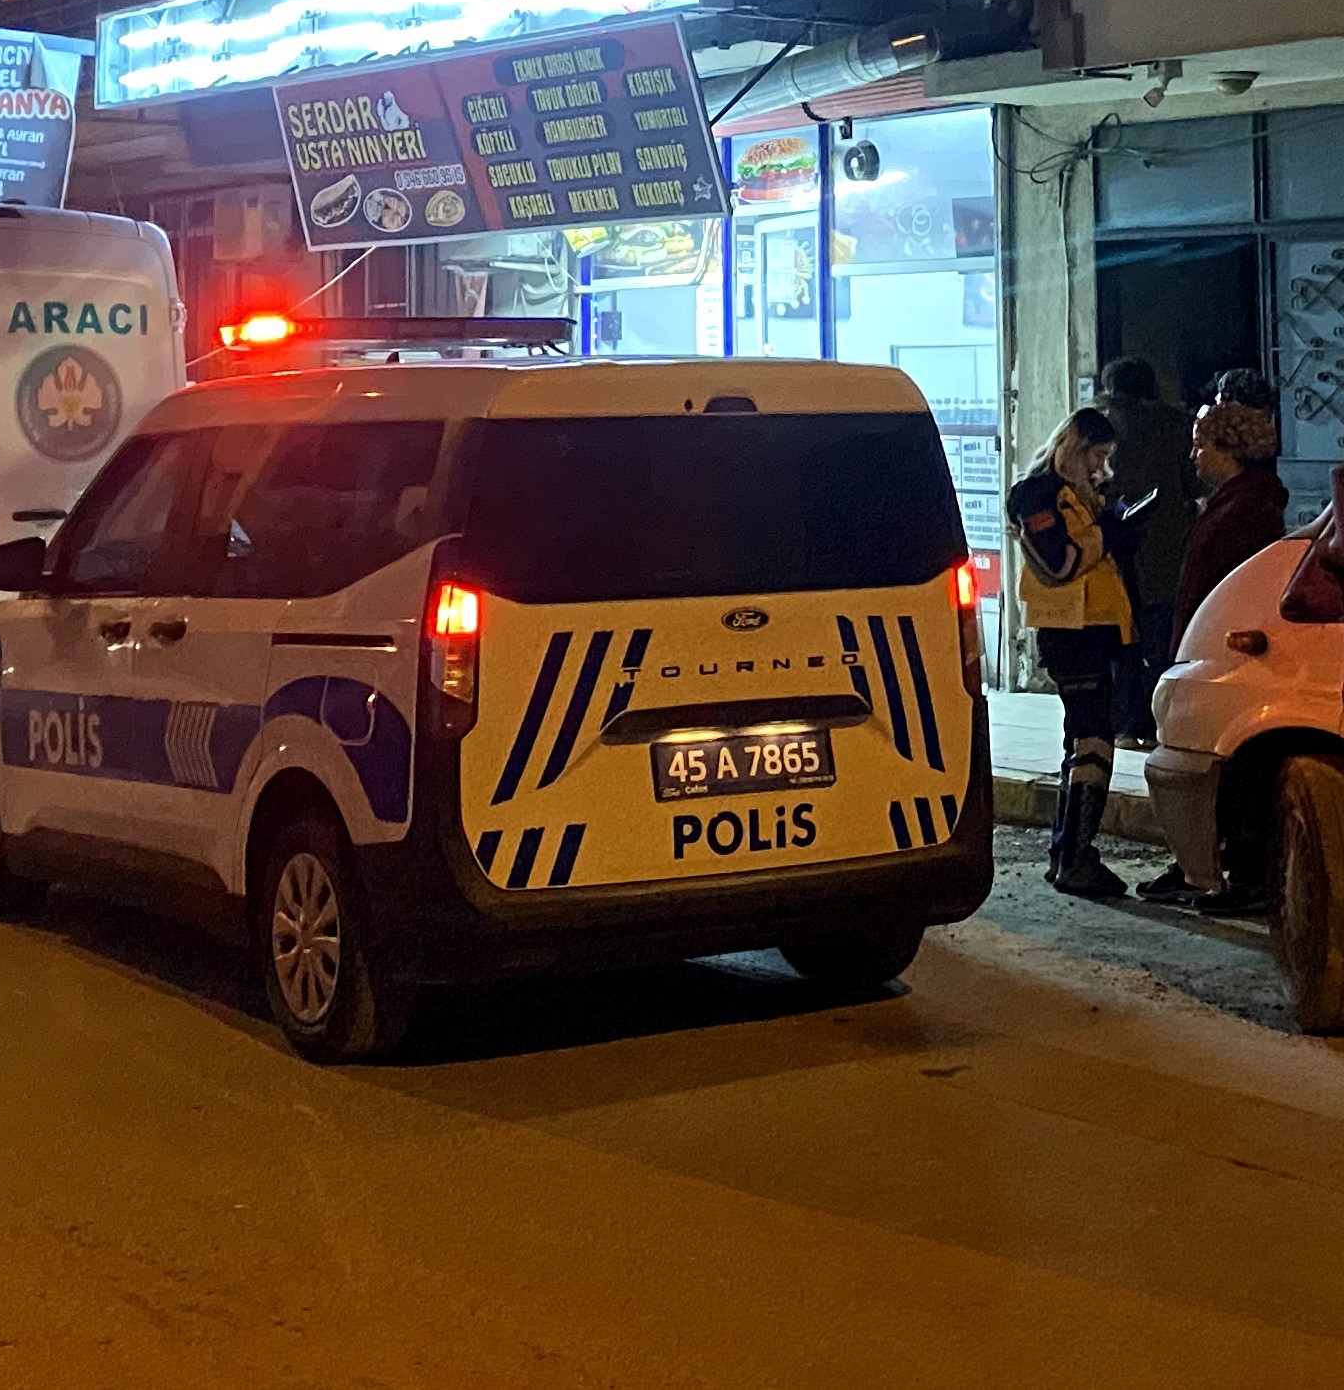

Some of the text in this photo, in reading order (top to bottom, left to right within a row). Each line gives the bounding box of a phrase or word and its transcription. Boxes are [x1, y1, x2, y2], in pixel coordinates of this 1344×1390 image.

[627, 68, 677, 98] KARIŞIK
[287, 95, 379, 139] SERDAR
[543, 114, 608, 144] HAMBURGER
[381, 122, 427, 162] YERİ
[636, 140, 688, 172] SANDVİÇ
[488, 161, 537, 188] SUCUKLU
[568, 187, 620, 213] MENEMEN
[632, 180, 685, 209] KOKOREÇ
[8, 301, 149, 337] ARACI
[623, 653, 858, 680] TOURNEO
[28, 696, 104, 768] POLİS
[668, 741, 820, 783] 45 A 7865
